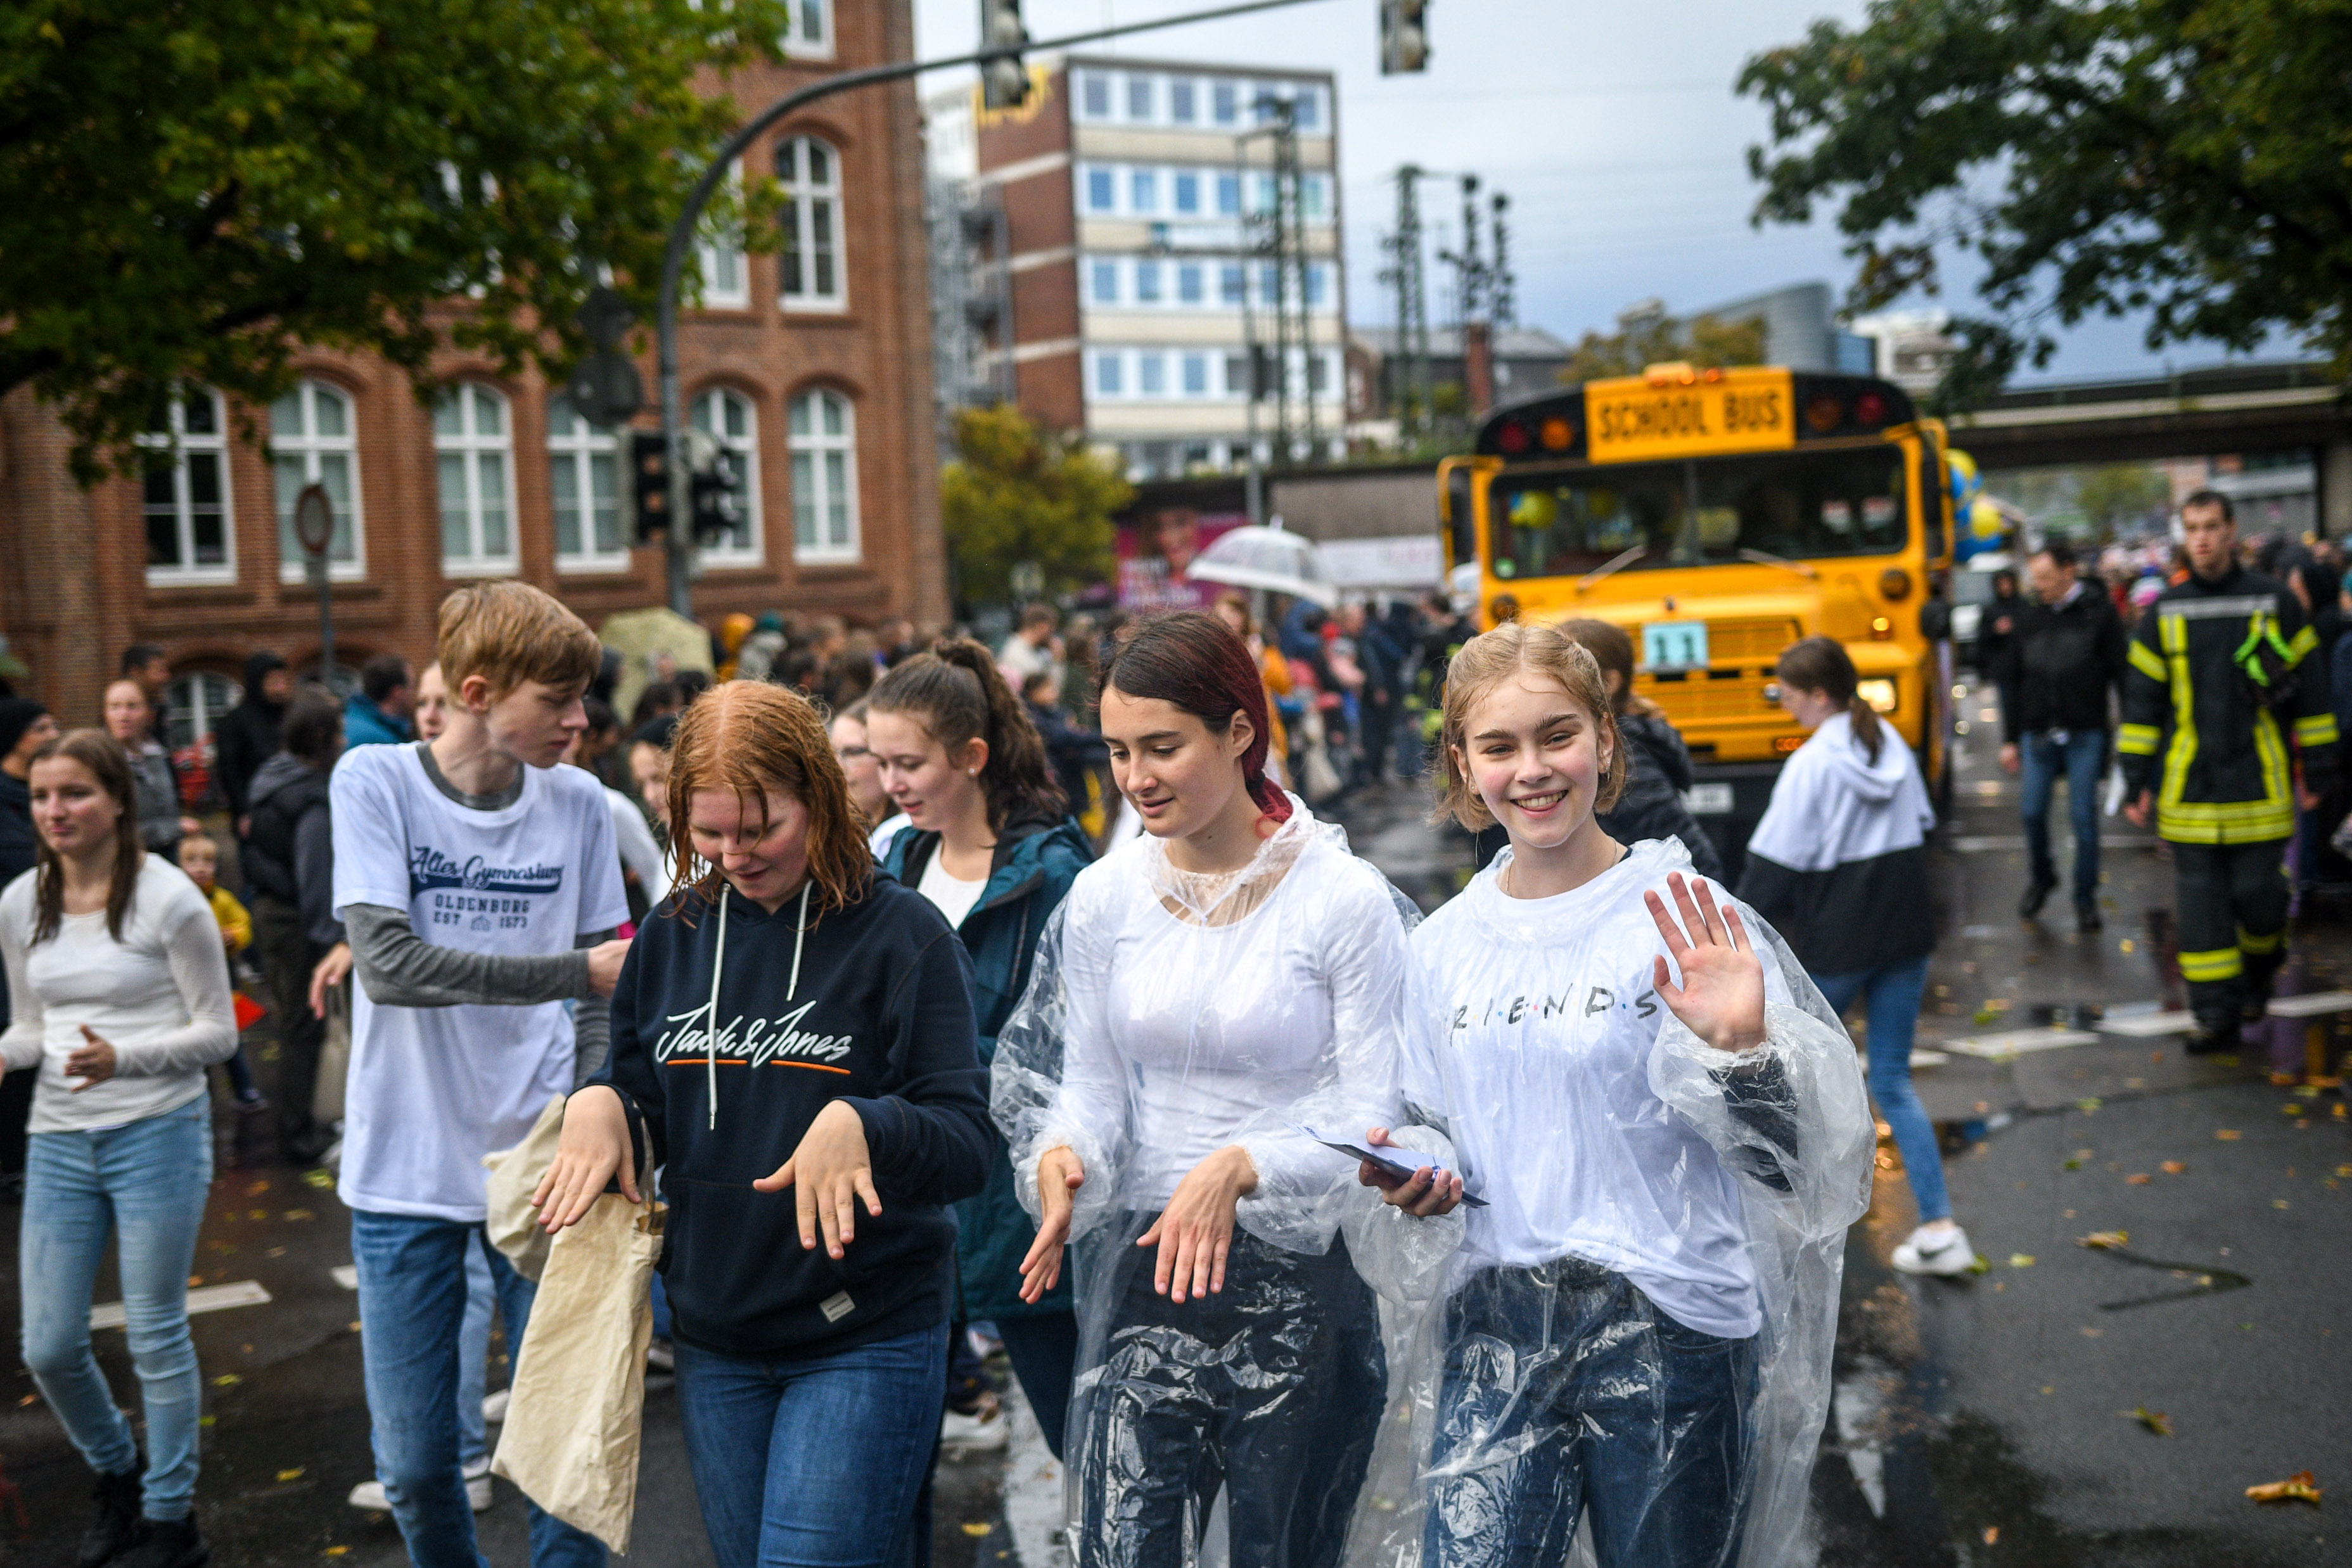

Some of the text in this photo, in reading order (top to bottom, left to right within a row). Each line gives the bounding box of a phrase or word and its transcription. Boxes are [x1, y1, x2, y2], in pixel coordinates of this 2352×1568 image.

[1597, 388, 1783, 441] SCHOOL BUS
[463, 855, 565, 887] Gymnasium
[435, 893, 530, 914] OLDENBURG
[433, 911, 461, 926] EST
